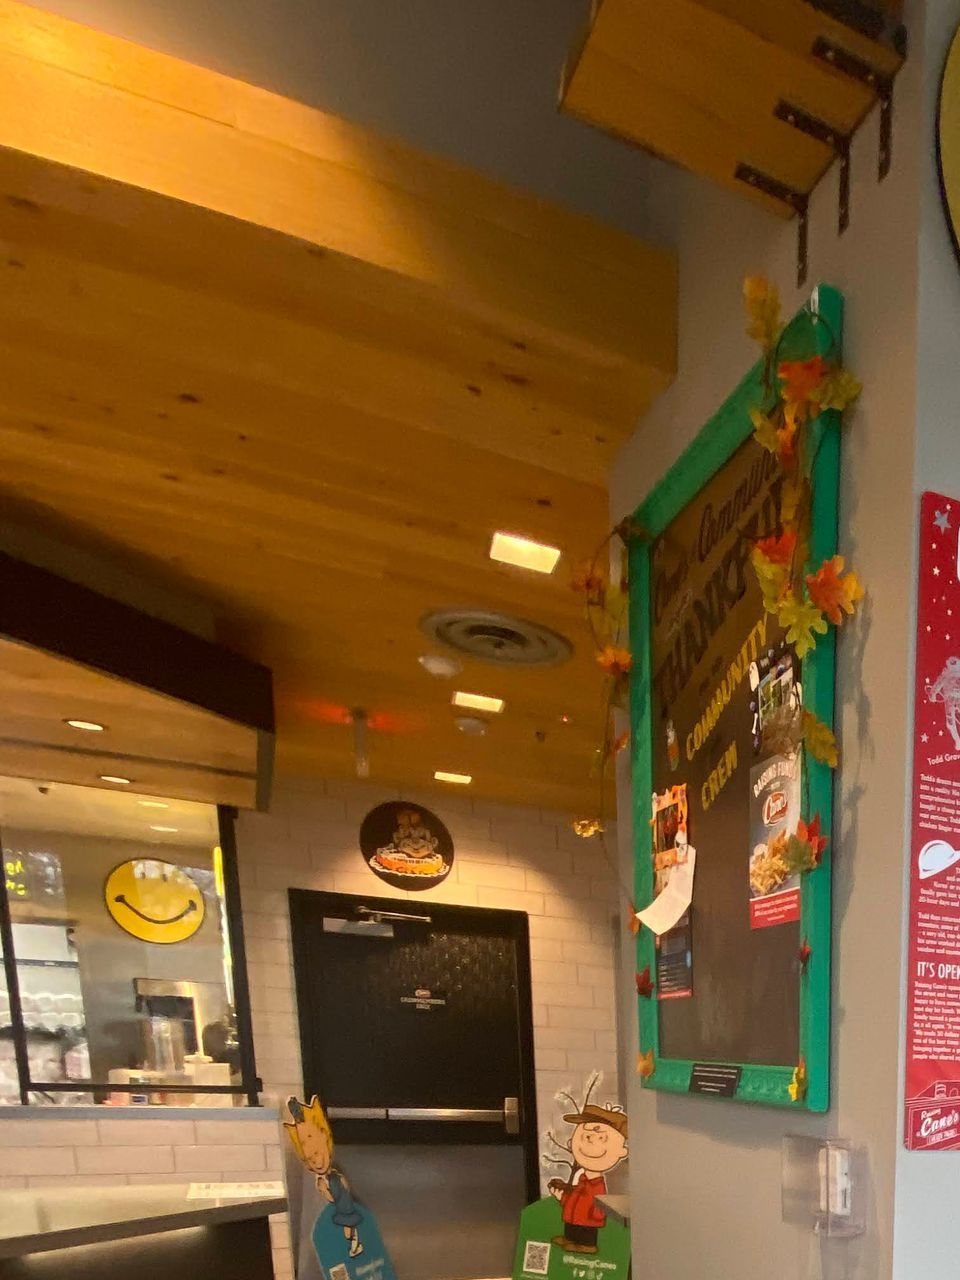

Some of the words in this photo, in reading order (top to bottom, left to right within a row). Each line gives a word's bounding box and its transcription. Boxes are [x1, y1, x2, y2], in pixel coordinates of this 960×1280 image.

[686, 611, 768, 761] COMMUNITY
[928, 755, 943, 766] Todd
[702, 740, 737, 811] CREW
[917, 961, 936, 978] IT'S
[920, 1109, 960, 1137] Cane's
